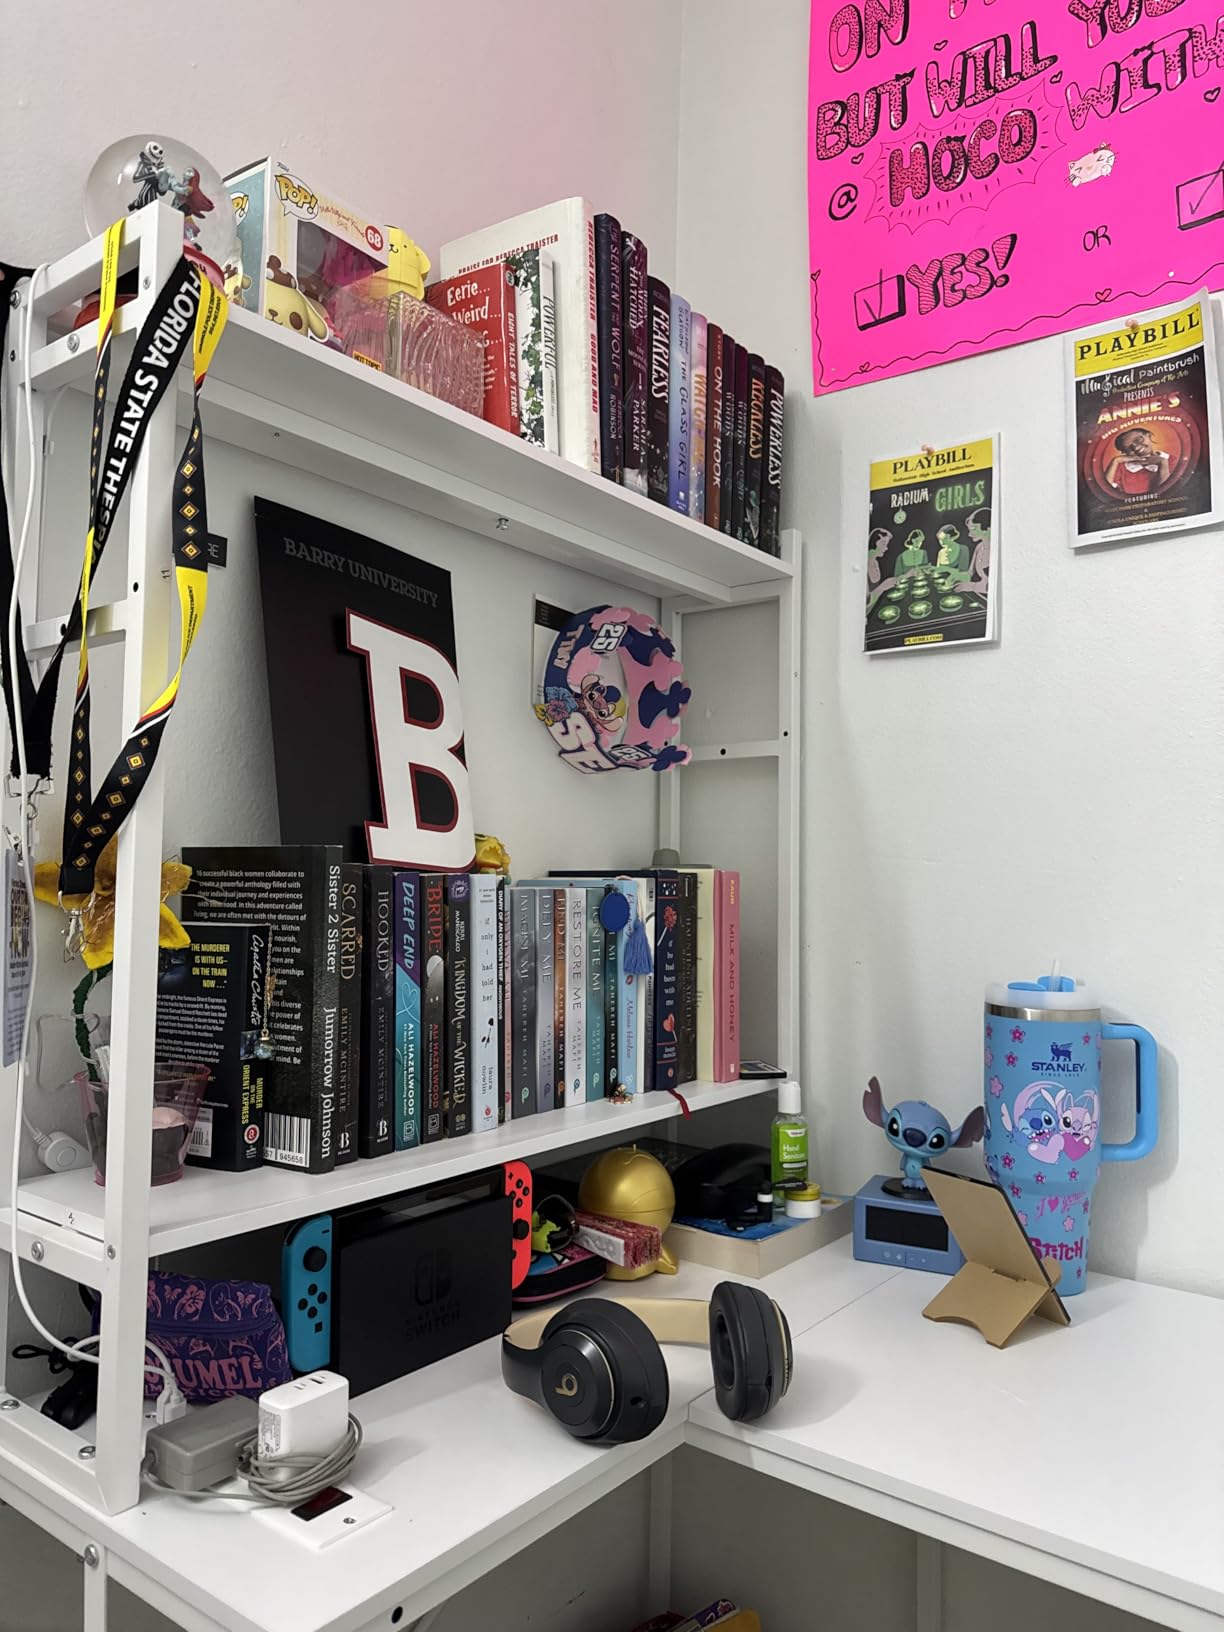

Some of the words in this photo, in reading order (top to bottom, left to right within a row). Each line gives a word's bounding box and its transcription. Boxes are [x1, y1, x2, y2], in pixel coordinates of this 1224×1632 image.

[829, 0, 909, 73] ON
[816, 68, 916, 160] BUT
[926, 20, 1058, 118] WILL
[829, 183, 858, 220] @
[889, 108, 1038, 207] HOCO
[1065, 14, 1224, 130] WITH
[274, 175, 318, 215] POP!
[367, 228, 381, 248] 68
[526, 234, 559, 251] TRAISTER
[1082, 225, 1112, 252] OR
[611, 245, 620, 310] SERPENT
[906, 233, 1018, 315] YES!
[630, 266, 638, 330] HATCHED
[142, 270, 202, 369] FLORIDA
[543, 295, 556, 370] POWERFUL
[1078, 311, 1200, 360] PLAYBILL
[611, 328, 621, 370] WOLF
[652, 304, 669, 404] FEARLESS
[714, 367, 722, 394] ON
[1124, 386, 1154, 402] PRESENTS
[114, 368, 158, 454] STATE
[510, 385, 518, 418] TERROR
[680, 387, 688, 436] GLASS
[714, 399, 722, 430] THE
[632, 400, 640, 451] PARKER
[737, 401, 745, 446] WOODS
[749, 378, 764, 460] RECKLESS
[768, 387, 784, 490] POWERLESS
[678, 441, 687, 480] GIRL
[713, 436, 721, 488] HOOK
[892, 448, 972, 475] PLAYBILL
[890, 487, 929, 508] RADIUM
[934, 480, 985, 512] GIRLS
[1124, 493, 1158, 504] FEATURING
[283, 537, 345, 573] BARRY
[347, 559, 439, 608] UNIVERSITY
[591, 623, 626, 651] 25
[346, 607, 476, 873] B
[203, 869, 229, 878] successful
[229, 870, 244, 878] black
[265, 870, 298, 878] collaborate
[244, 881, 272, 890] anthology
[272, 881, 287, 889] filled
[287, 881, 301, 889] with
[327, 865, 341, 910] Sister
[236, 891, 257, 900] journey
[257, 891, 269, 899] and
[269, 891, 303, 900] experiences
[256, 902, 285, 910] adventure
[285, 902, 303, 910] called
[402, 881, 415, 934] DEEP
[227, 911, 242, 919] often
[253, 912, 267, 920] with
[267, 912, 276, 920] the
[277, 913, 299, 921] detours
[299, 913, 307, 921] of
[328, 914, 340, 923] 2
[340, 883, 357, 980] SCARRED
[376, 891, 389, 972] HOOKED
[426, 881, 443, 953] BRIDE
[498, 922, 504, 931] AN
[520, 895, 529, 951] IMAGINE
[542, 895, 551, 943] DEFY
[200, 943, 230, 953] MURDERER
[290, 946, 301, 954] the
[326, 928, 340, 973] Sister
[480, 932, 494, 941] only
[573, 900, 582, 980] RESTORE
[592, 906, 601, 966] IGNITE
[201, 956, 215, 964] WITH
[402, 937, 415, 970] END
[481, 963, 493, 971] had
[542, 954, 551, 984] ME
[192, 967, 200, 976] ON
[200, 967, 210, 976] THE
[211, 967, 228, 977] TRAIN
[202, 979, 216, 989] NOW
[481, 978, 494, 987] told
[520, 959, 529, 983] ME
[592, 972, 601, 997] ME
[280, 1000, 302, 1009] diverse
[452, 957, 467, 1025] KINGDOM
[482, 993, 493, 1001] her
[573, 987, 582, 1010] ME
[664, 986, 675, 994] with
[273, 1021, 303, 1031] celebrates
[275, 1012, 293, 1020] power
[293, 1011, 301, 1020] of
[275, 1056, 292, 1064] mind.
[293, 1056, 301, 1065] Be
[323, 1007, 338, 1088] Jumorrow
[242, 1064, 251, 1091] ORIENT
[338, 1050, 347, 1112] MCINTIRE
[453, 1041, 467, 1109] WICKED
[1032, 1062, 1085, 1072] STANLEY
[241, 1092, 250, 1125] EXPRESS
[255, 1077, 264, 1109] MURDER
[320, 1093, 335, 1159] Johnson
[783, 1143, 800, 1152] Hand
